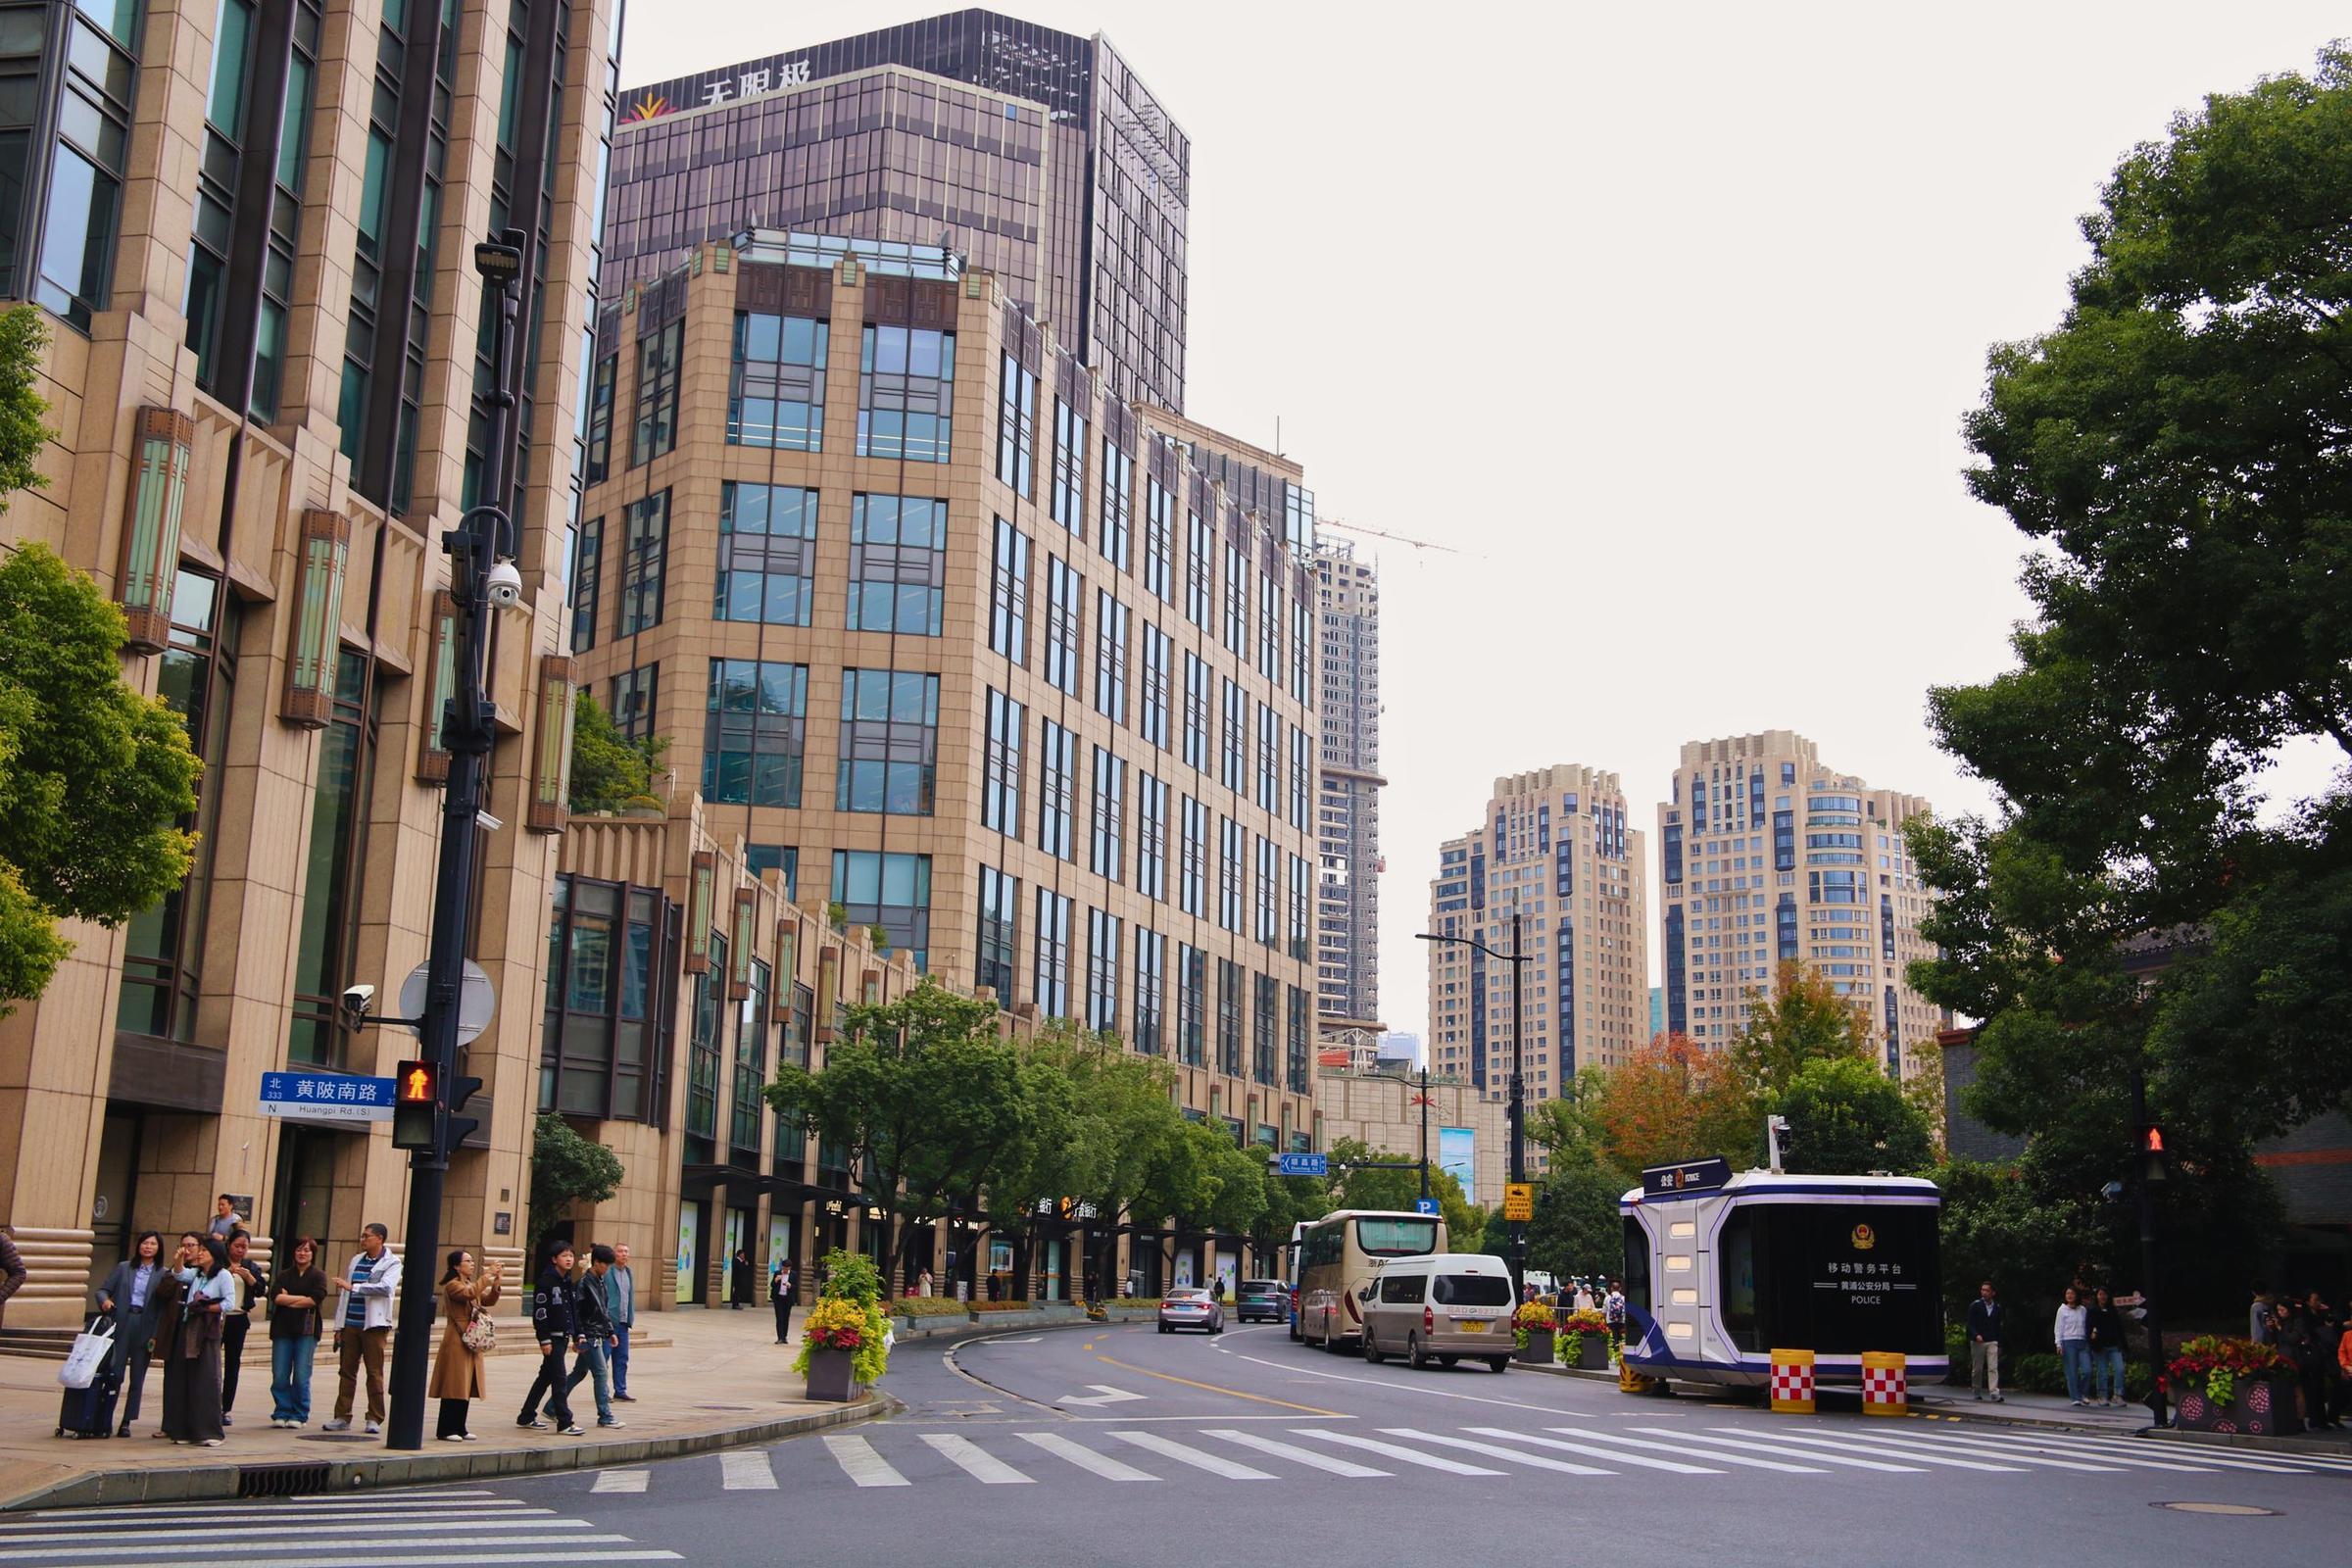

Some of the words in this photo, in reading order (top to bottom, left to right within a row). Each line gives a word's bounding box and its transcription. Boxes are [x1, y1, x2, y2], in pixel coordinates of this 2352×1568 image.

[702, 59, 810, 105] 无限极
[270, 1078, 282, 1089] 北
[267, 1091, 282, 1100] 333
[296, 1080, 377, 1102] 黄陂南路
[268, 1104, 276, 1113] N
[299, 1105, 336, 1116] Huangpi
[1419, 1201, 1431, 1213] P
[1828, 1262, 1901, 1274] 移动警务平台
[1841, 1281, 1890, 1291] 黄浦公安分局
[1851, 1296, 1881, 1304] POLICE
